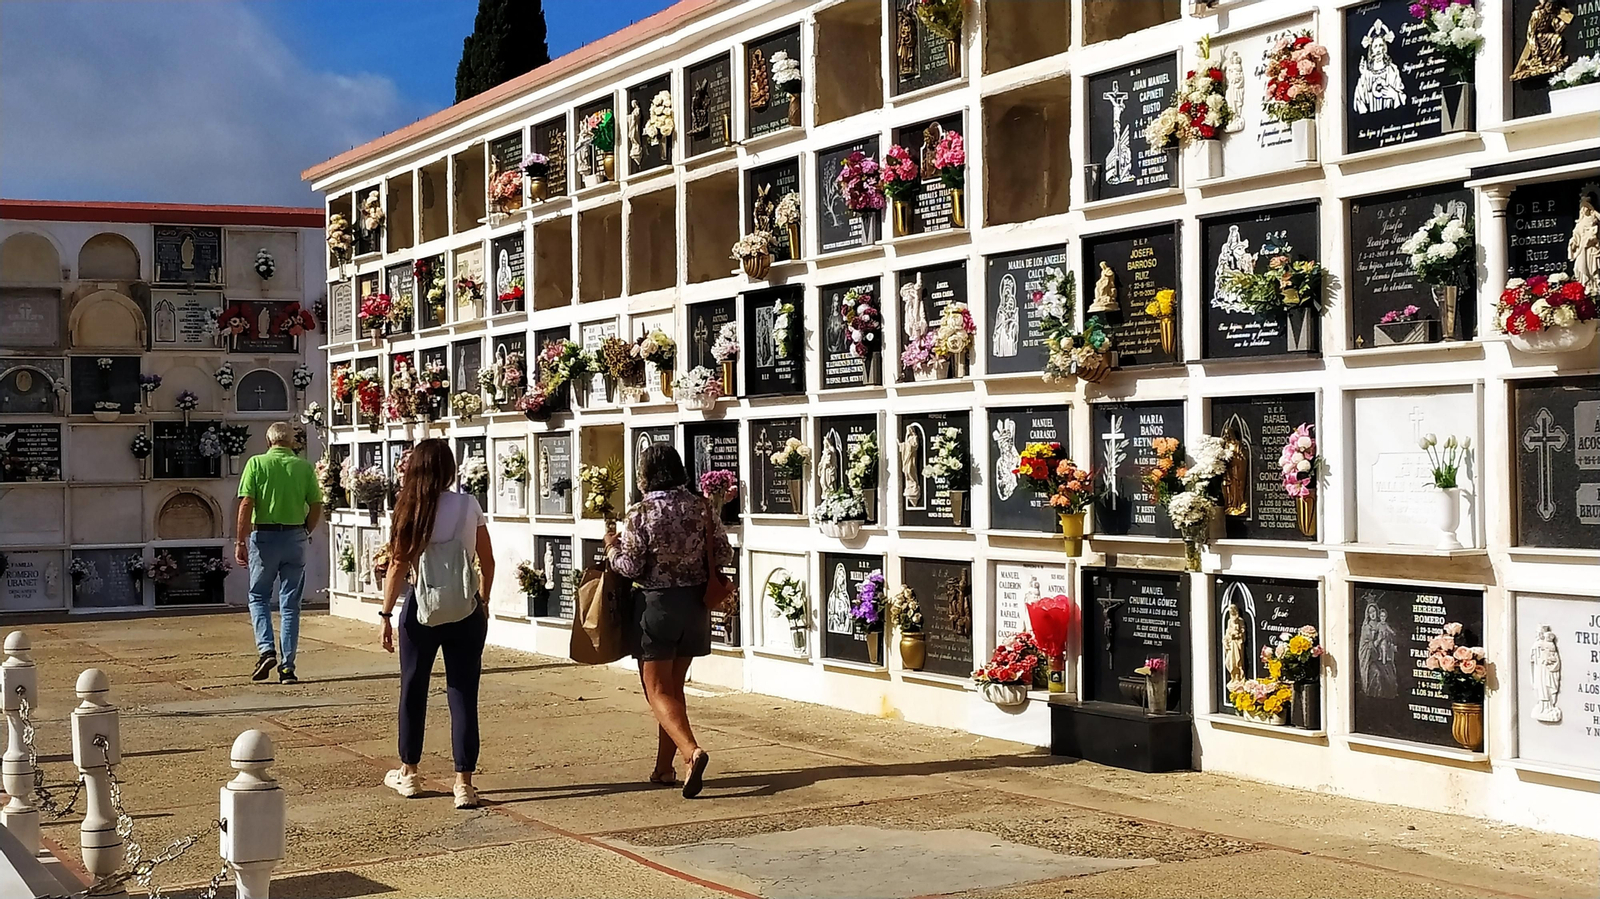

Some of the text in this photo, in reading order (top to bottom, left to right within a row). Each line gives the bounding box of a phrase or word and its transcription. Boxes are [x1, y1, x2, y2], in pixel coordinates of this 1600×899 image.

[1132, 73, 1170, 92] JUAN MANUEL
[1130, 247, 1154, 259] JOSEFA
[1127, 258, 1157, 271] BARROSO
[1135, 270, 1150, 280] RUIZ
[1032, 418, 1054, 428] MANUEL
[1139, 414, 1164, 425] MARIA
[1263, 414, 1288, 424] RAFAEL
[1029, 430, 1057, 439] CARRASCO
[1140, 424, 1163, 436] BAÑOS
[1262, 425, 1290, 435] ROMERO
[1262, 436, 1290, 445] PICARDO
[1579, 505, 1600, 518] BRU
[1141, 586, 1164, 595] MANUEL
[1129, 596, 1178, 608] CHUMILLA GÓMEZ
[1415, 595, 1443, 604] JOSEFA
[1271, 606, 1289, 620] José
[1412, 604, 1447, 615] HERRERA
[1413, 615, 1446, 625] ROMERO
[1575, 631, 1600, 645] TRU
